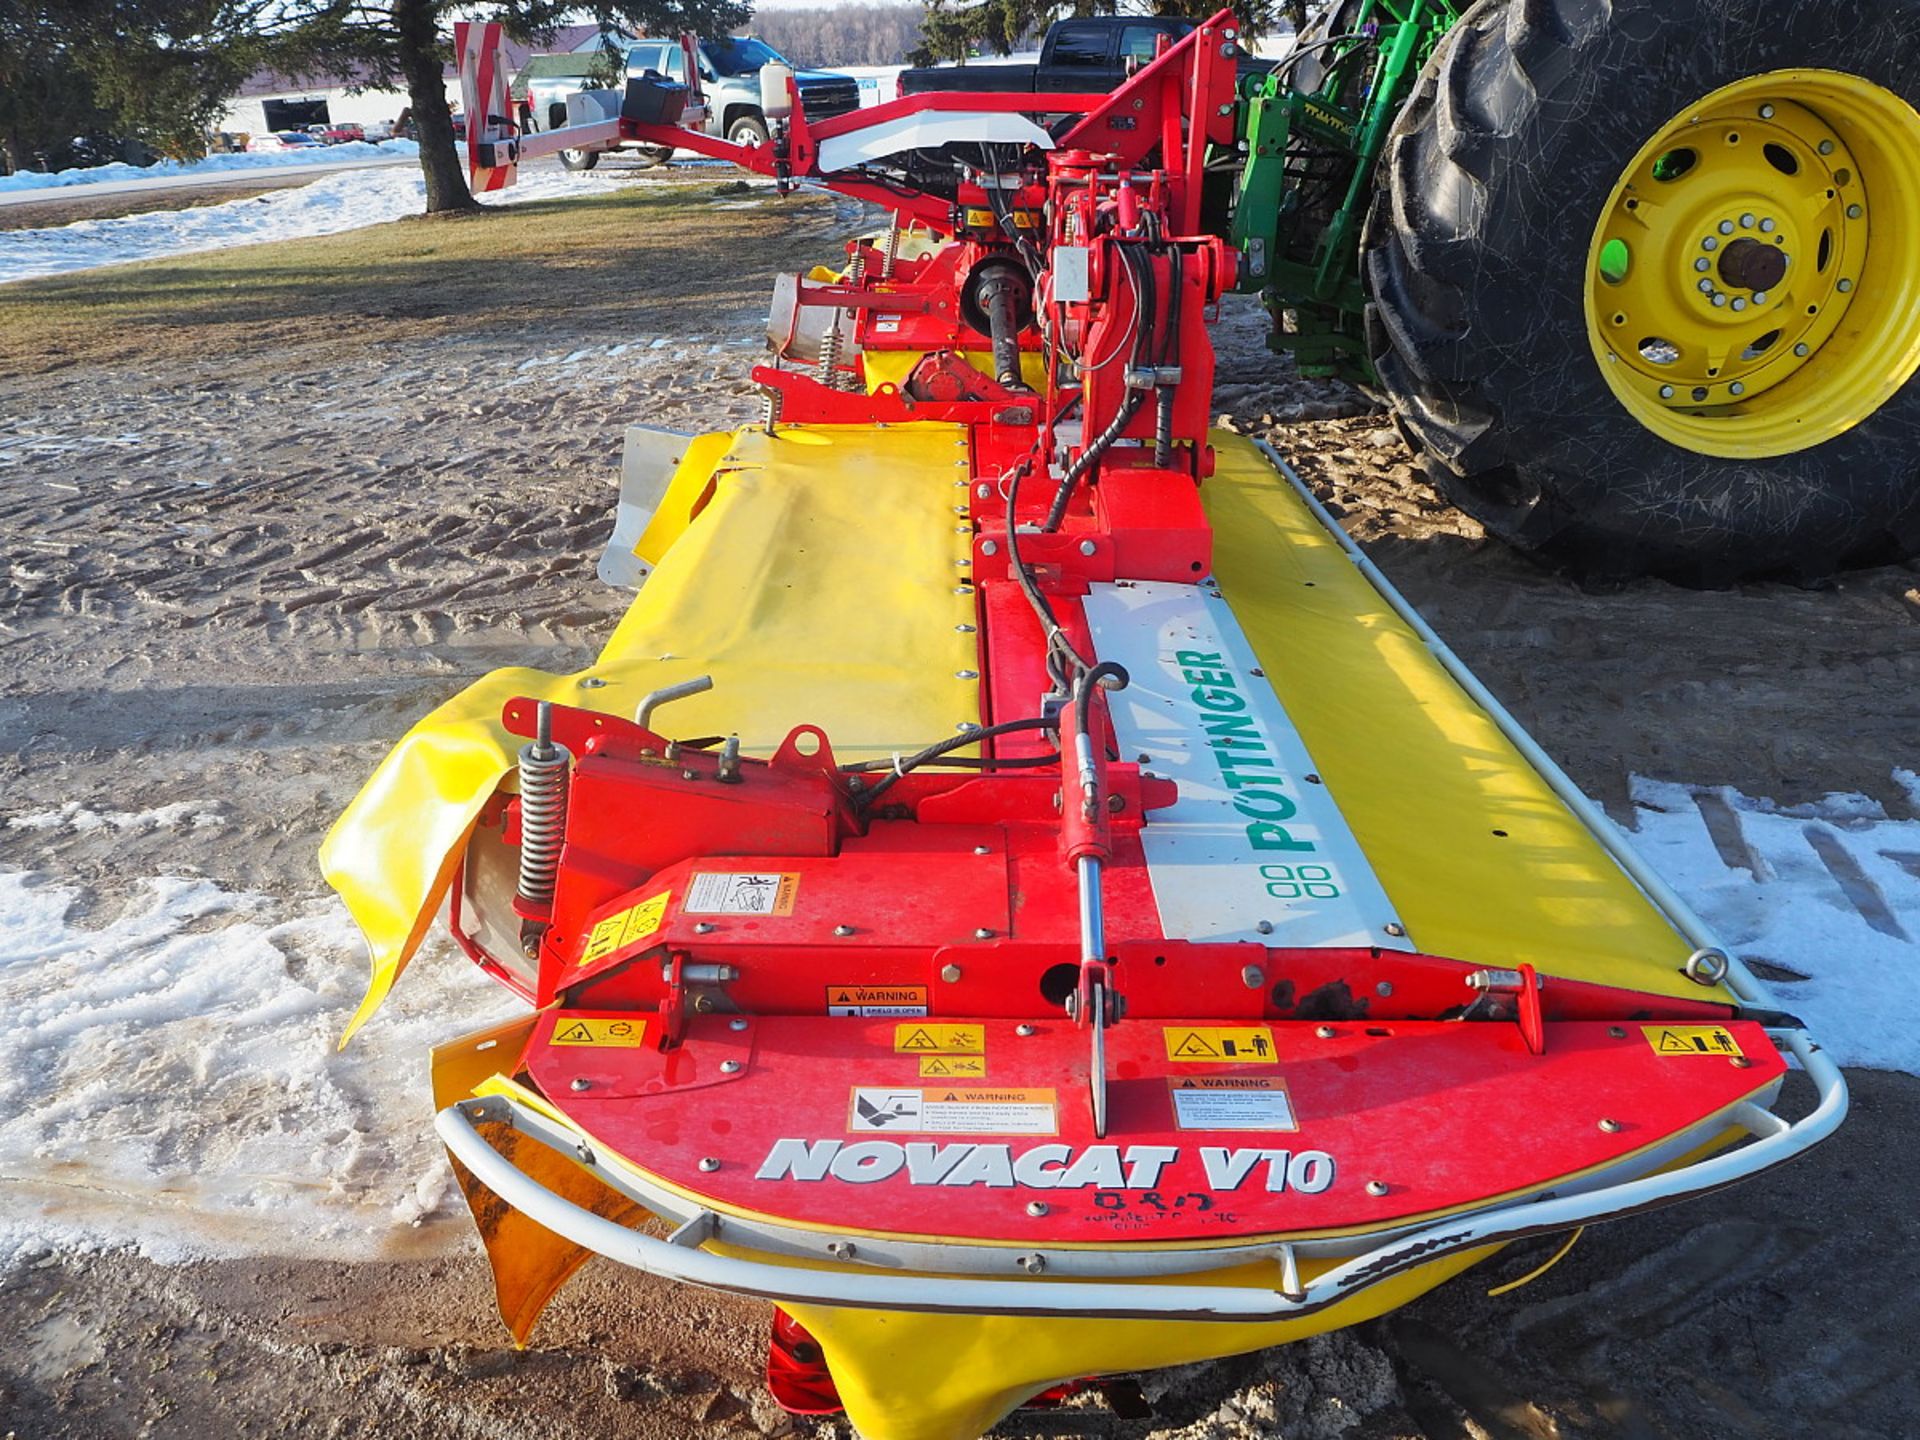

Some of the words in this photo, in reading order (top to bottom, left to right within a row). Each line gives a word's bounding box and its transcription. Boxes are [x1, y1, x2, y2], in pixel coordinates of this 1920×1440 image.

[1177, 650, 1316, 852] PÖTTINGER
[856, 991, 918, 1001] WARNING
[1201, 1079, 1270, 1088] WARNING
[965, 1093, 1026, 1102] WARNING
[755, 1138, 1179, 1190] NOVACAT
[1199, 1146, 1337, 1194] V10
